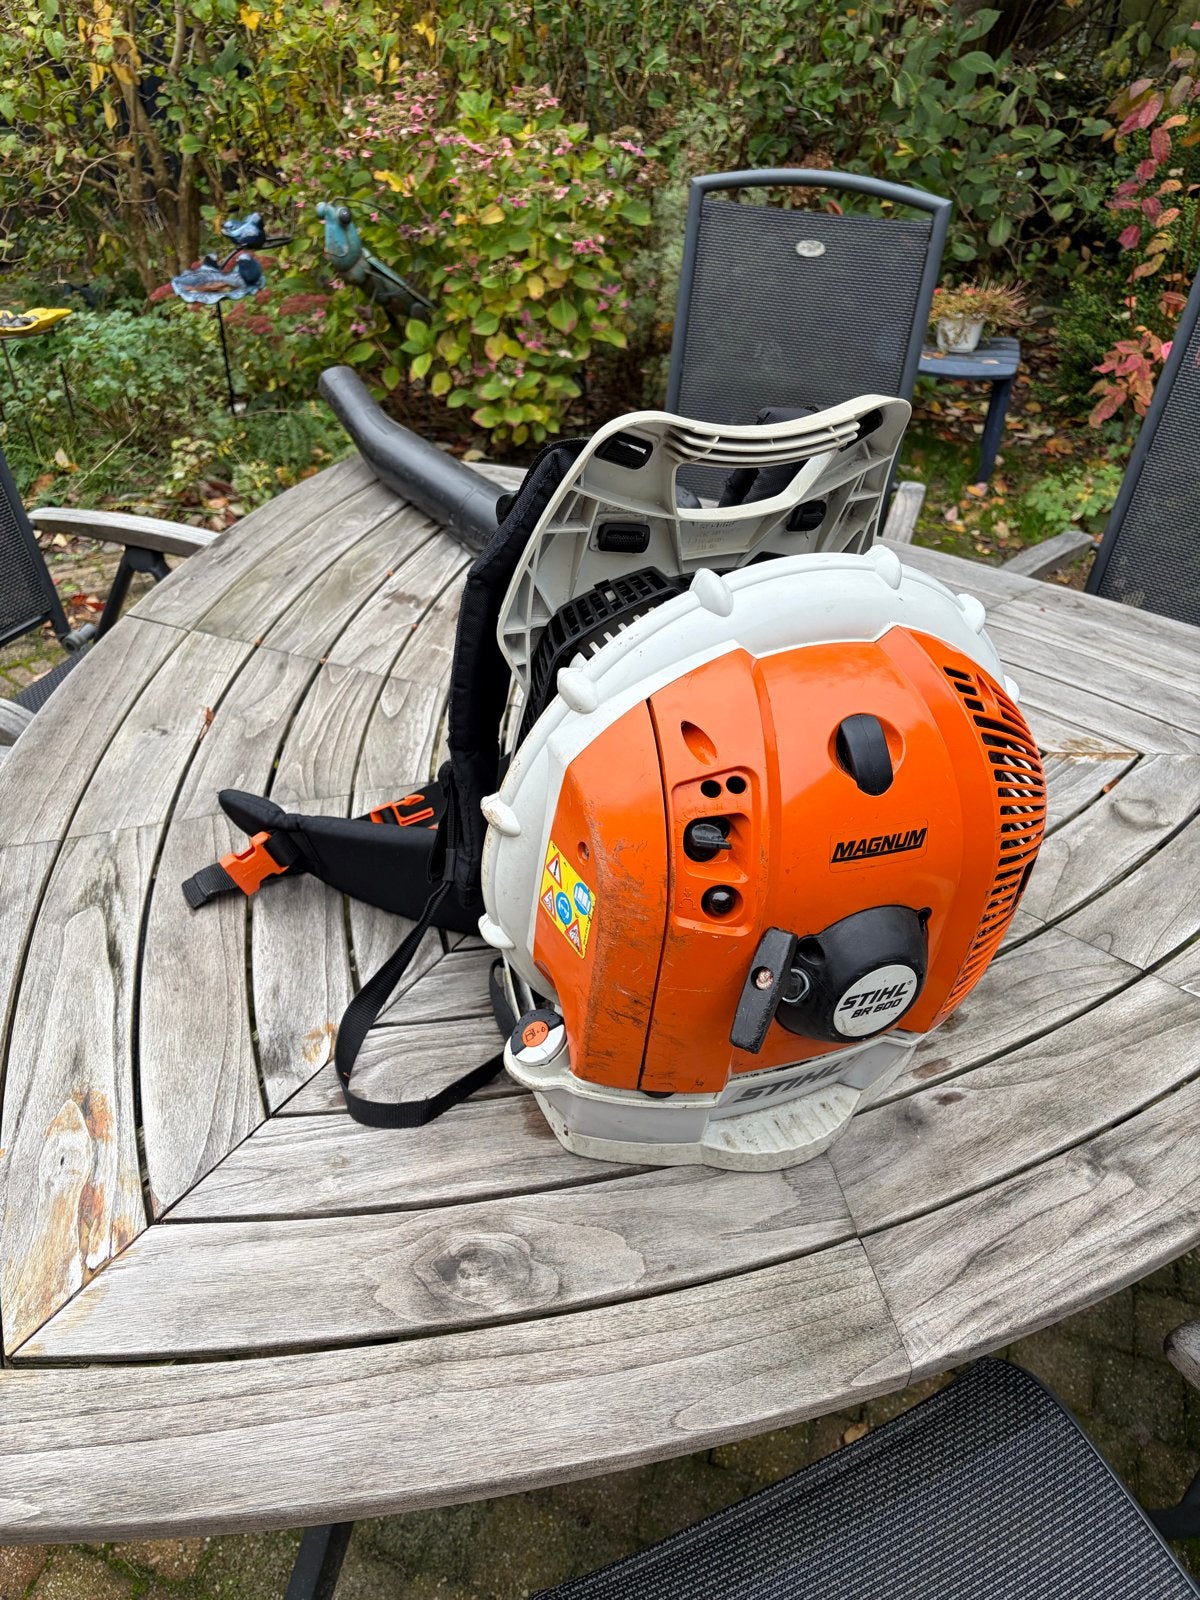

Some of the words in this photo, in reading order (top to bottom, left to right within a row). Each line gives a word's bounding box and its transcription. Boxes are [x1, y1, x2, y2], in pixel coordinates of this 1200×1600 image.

[831, 828, 927, 863] MAGNUM
[851, 1006, 873, 1018] BR
[873, 998, 902, 1013] 600
[733, 1061, 842, 1103] STIHL
